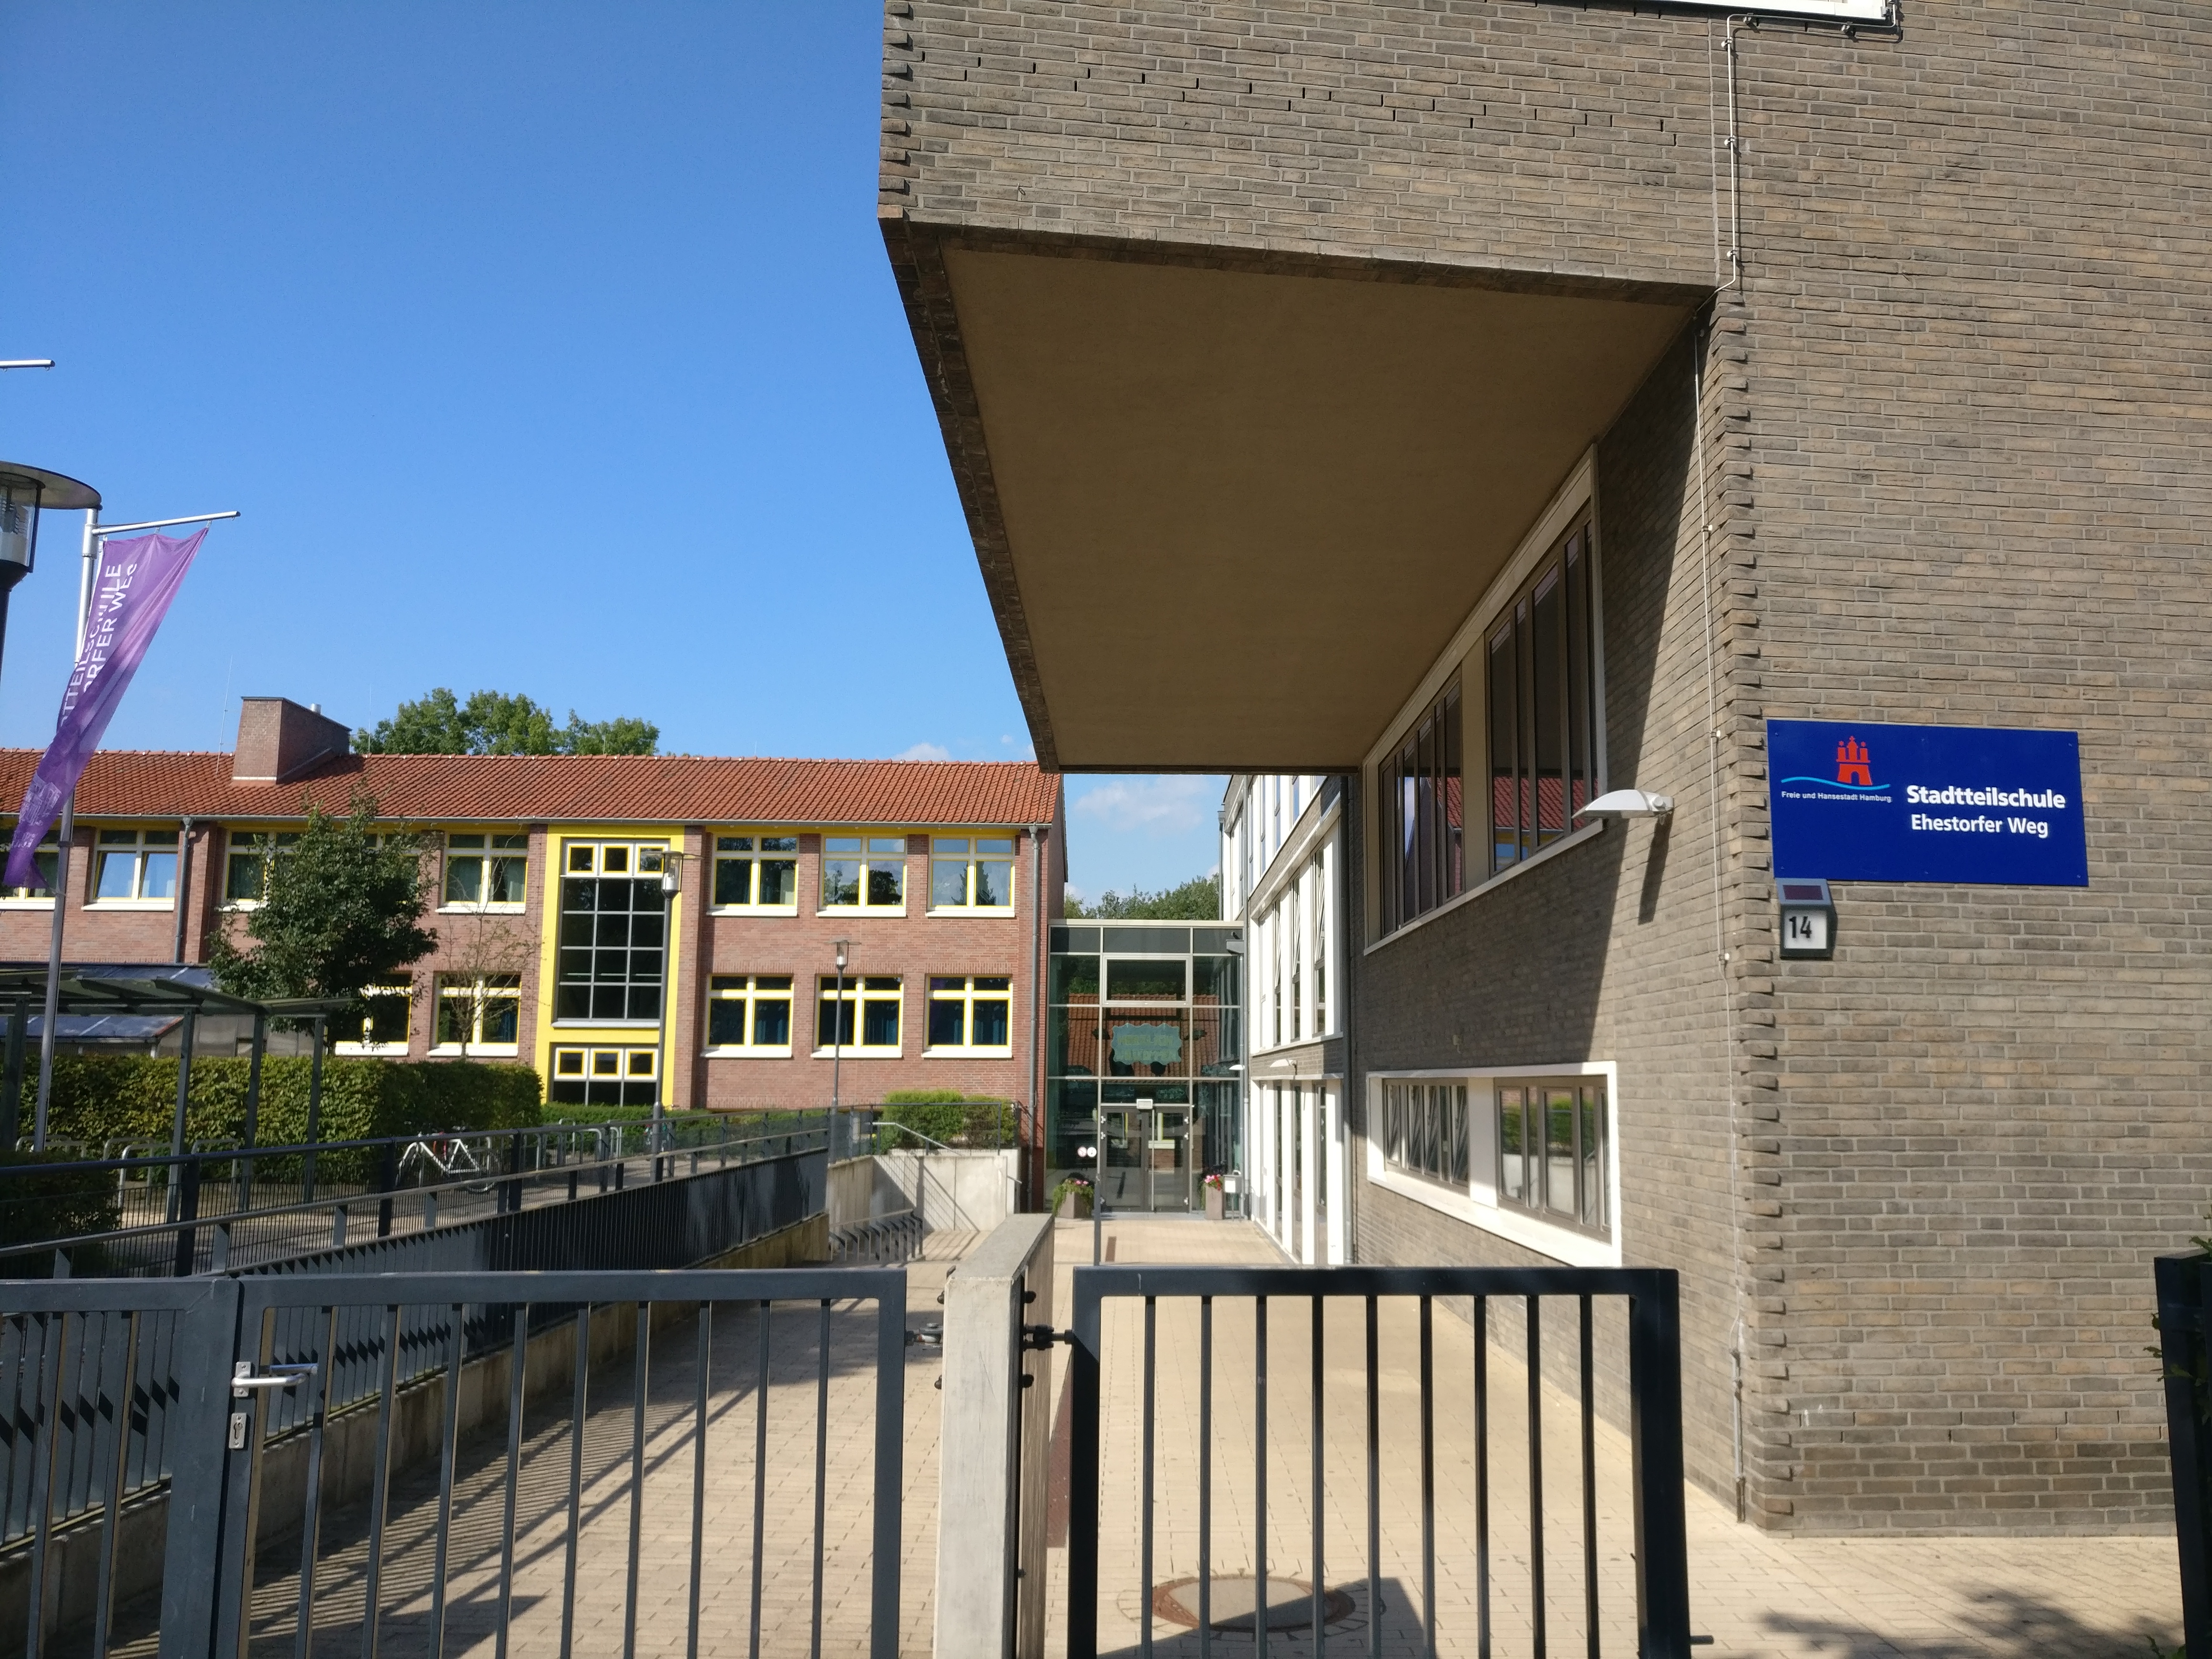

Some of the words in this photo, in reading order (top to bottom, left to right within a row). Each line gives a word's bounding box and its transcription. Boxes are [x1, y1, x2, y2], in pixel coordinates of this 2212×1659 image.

[1818, 792, 1858, 800] Hansestadt
[1859, 794, 1892, 803] Hamburg
[1907, 785, 2066, 809] Stadtteilschule
[1911, 813, 2003, 833] Ehestorfer
[2007, 817, 2048, 839] Weg
[1789, 916, 1812, 939] 14
